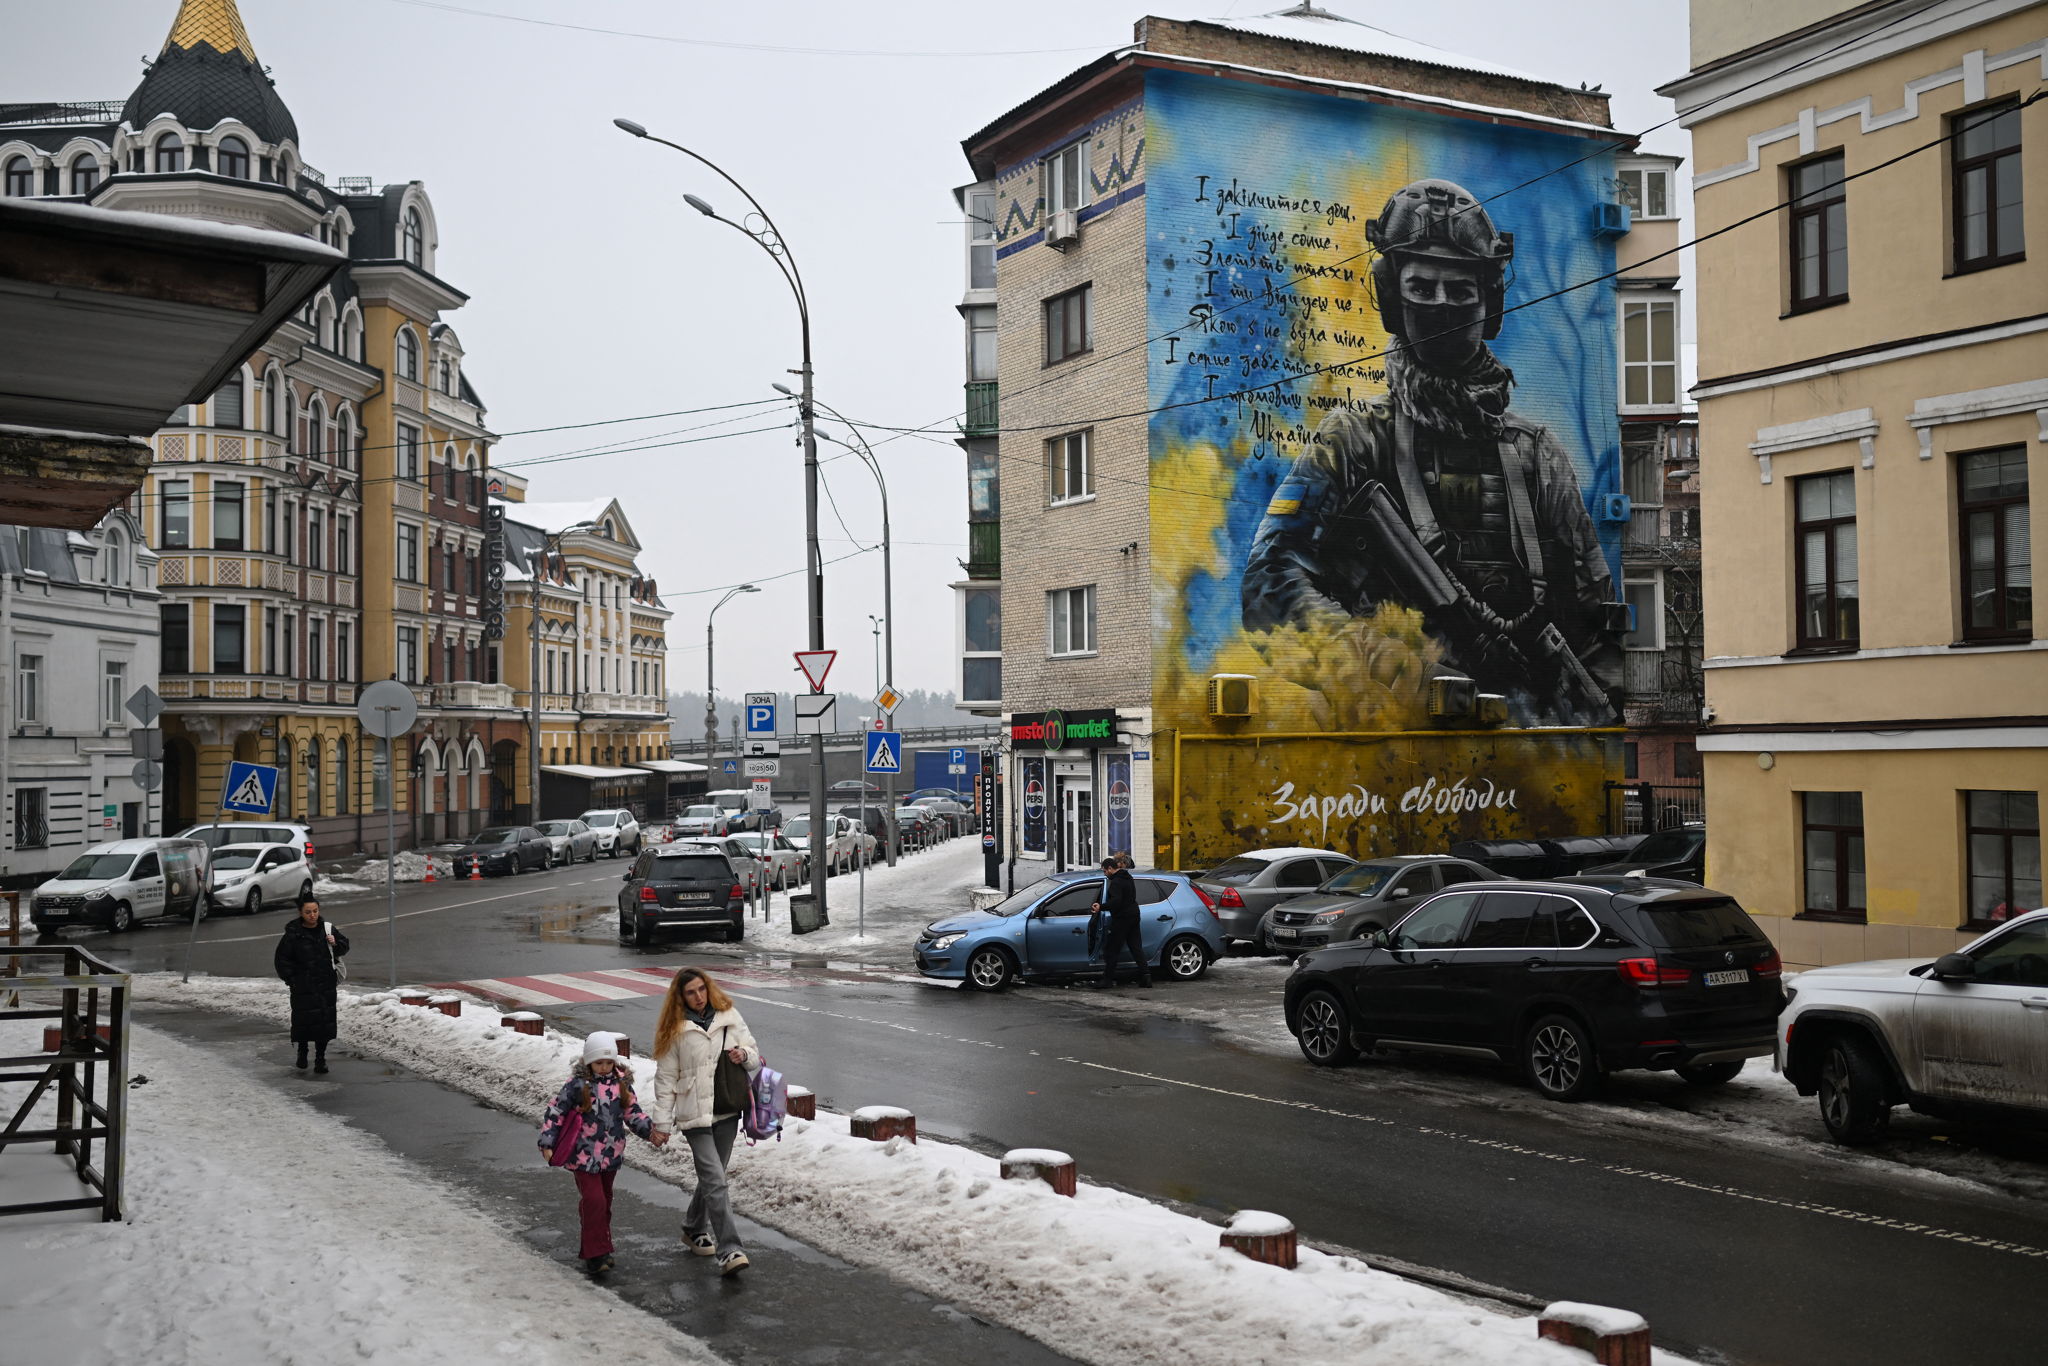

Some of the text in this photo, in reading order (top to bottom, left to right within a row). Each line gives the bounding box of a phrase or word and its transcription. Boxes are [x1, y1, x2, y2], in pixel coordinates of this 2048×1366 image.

[752, 696, 771, 704] ЗОНА
[1011, 722, 1045, 740] misto
[1066, 719, 1111, 738] market
[1027, 795, 1043, 804] PEPSI
[1110, 796, 1129, 805] PEPSI
[1267, 776, 1518, 845] Заради свободи
[1709, 973, 1721, 985] AA
[1721, 971, 1737, 983] 5117
